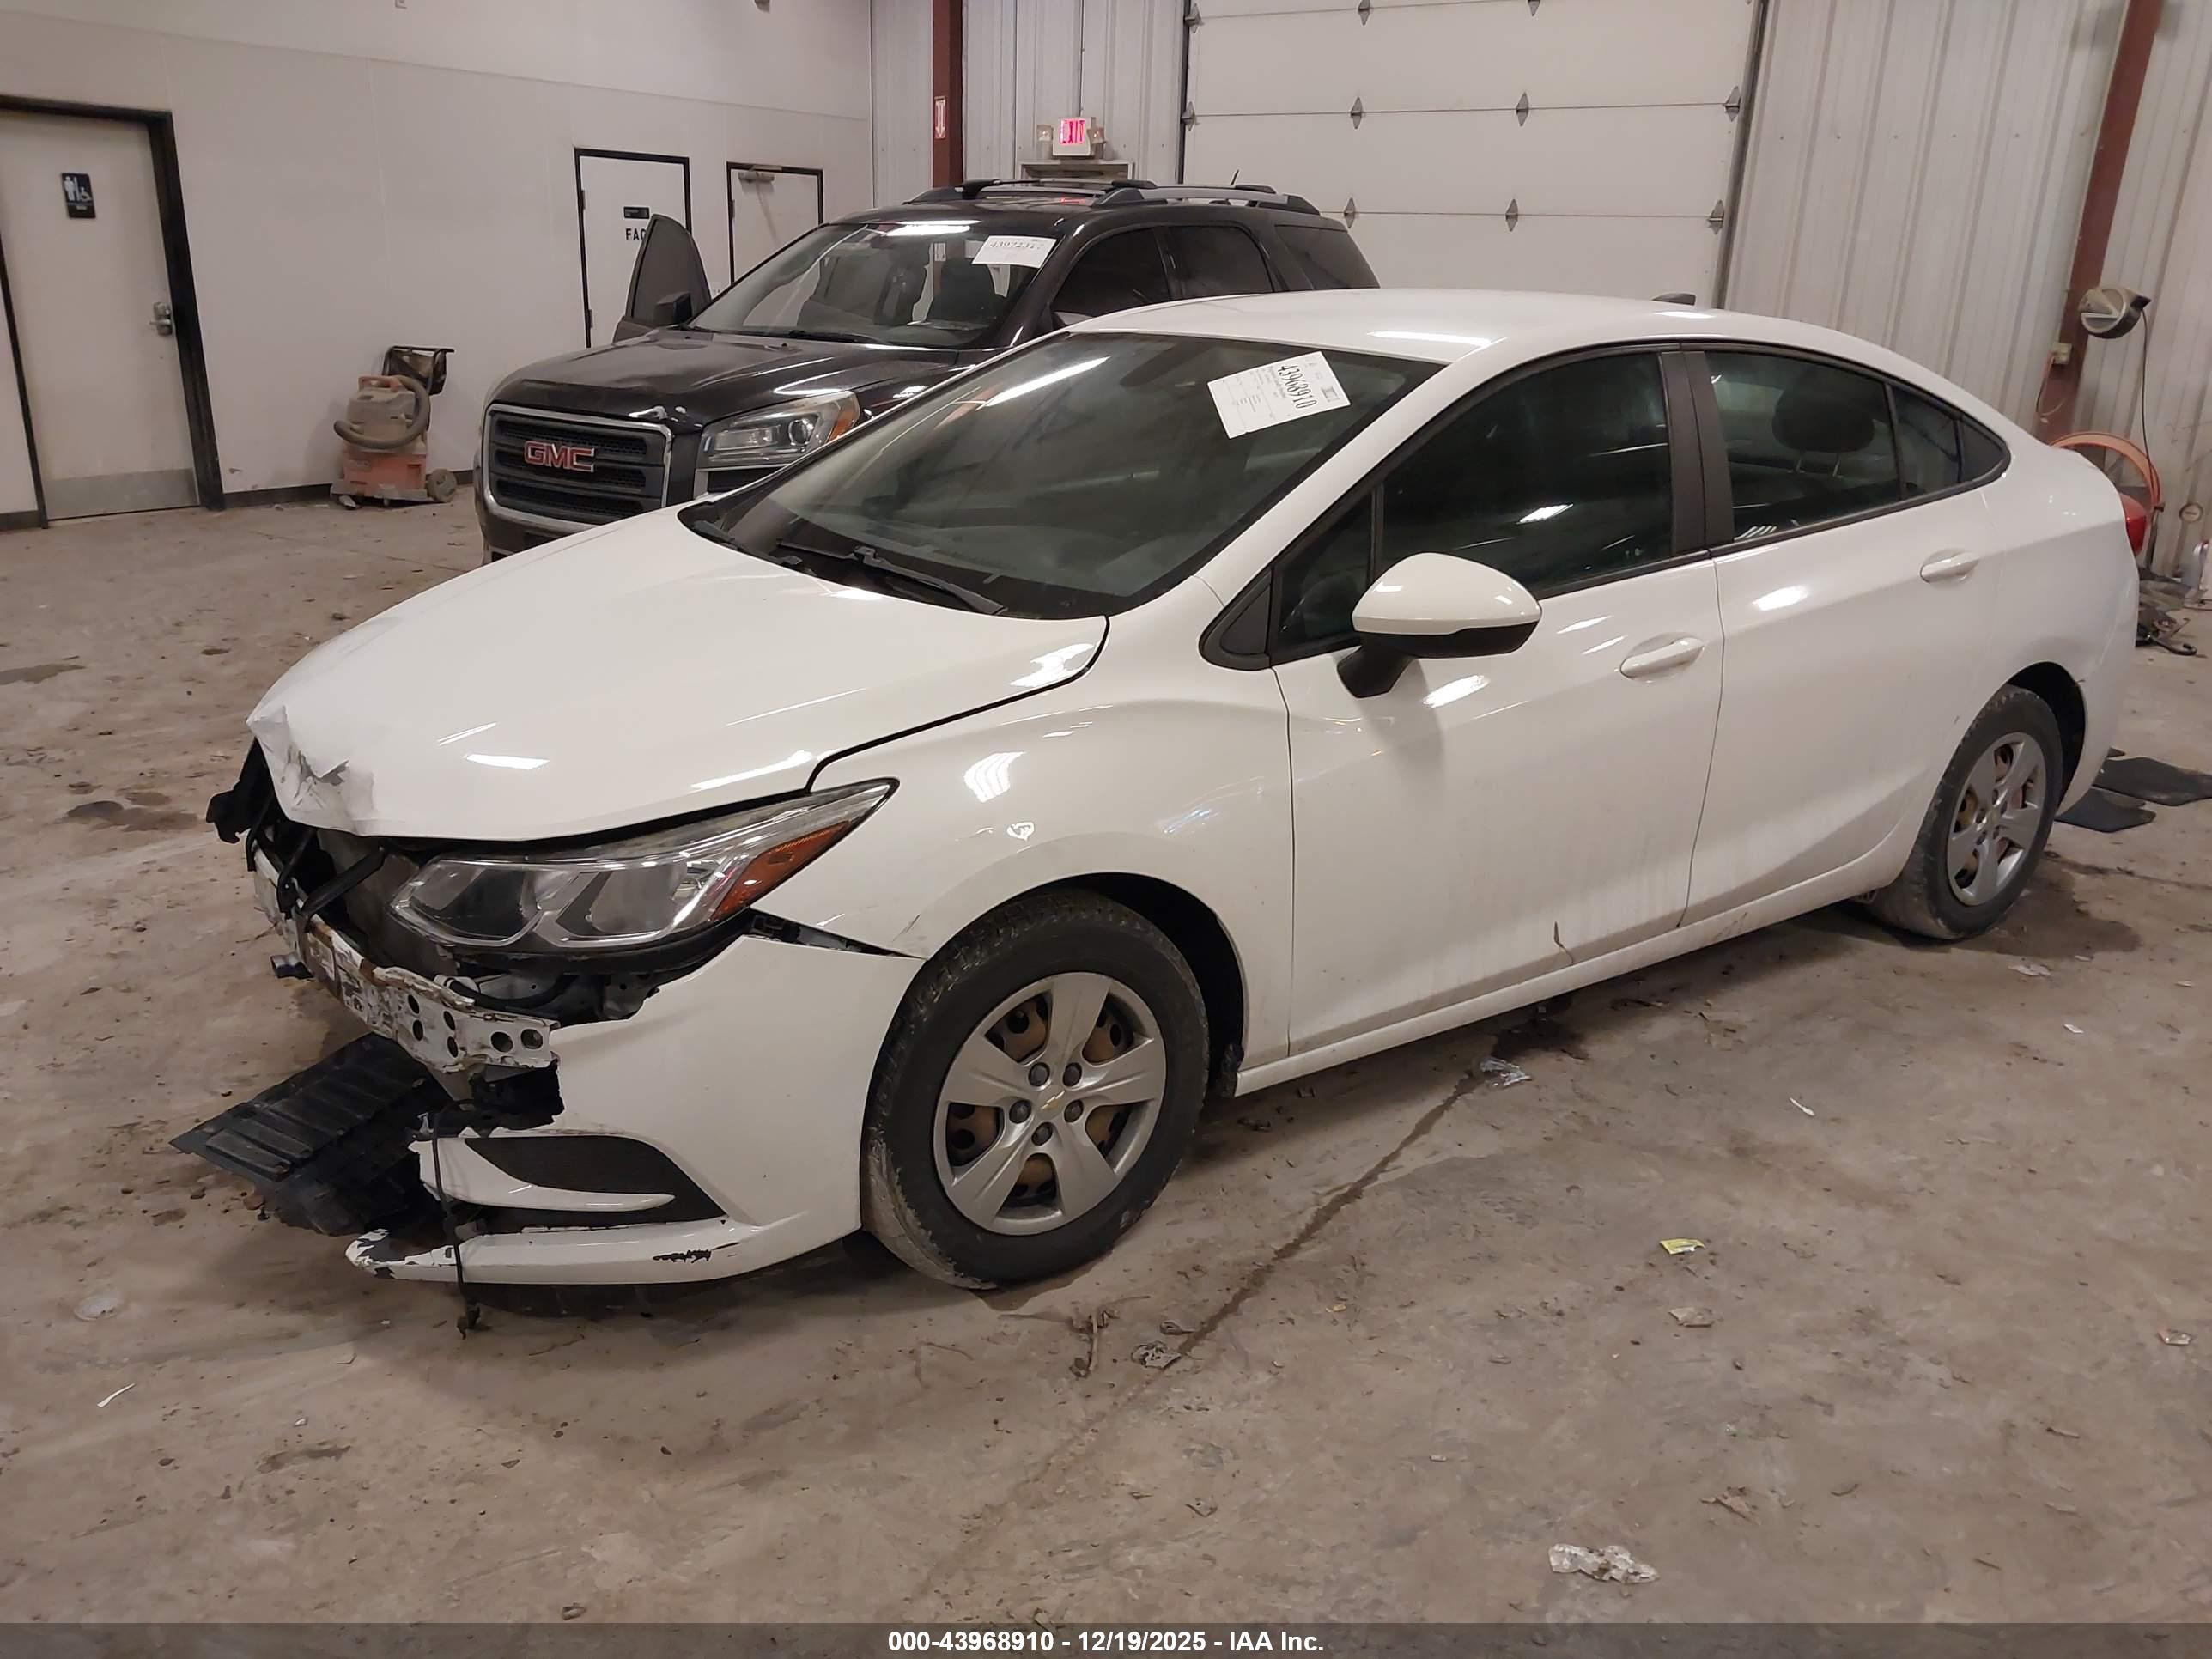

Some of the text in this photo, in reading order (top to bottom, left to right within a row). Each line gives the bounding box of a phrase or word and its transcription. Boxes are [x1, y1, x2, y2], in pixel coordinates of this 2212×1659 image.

[1059, 119, 1085, 144] EXIT
[1277, 364, 1317, 410] 43968910
[524, 441, 595, 473] GMC
